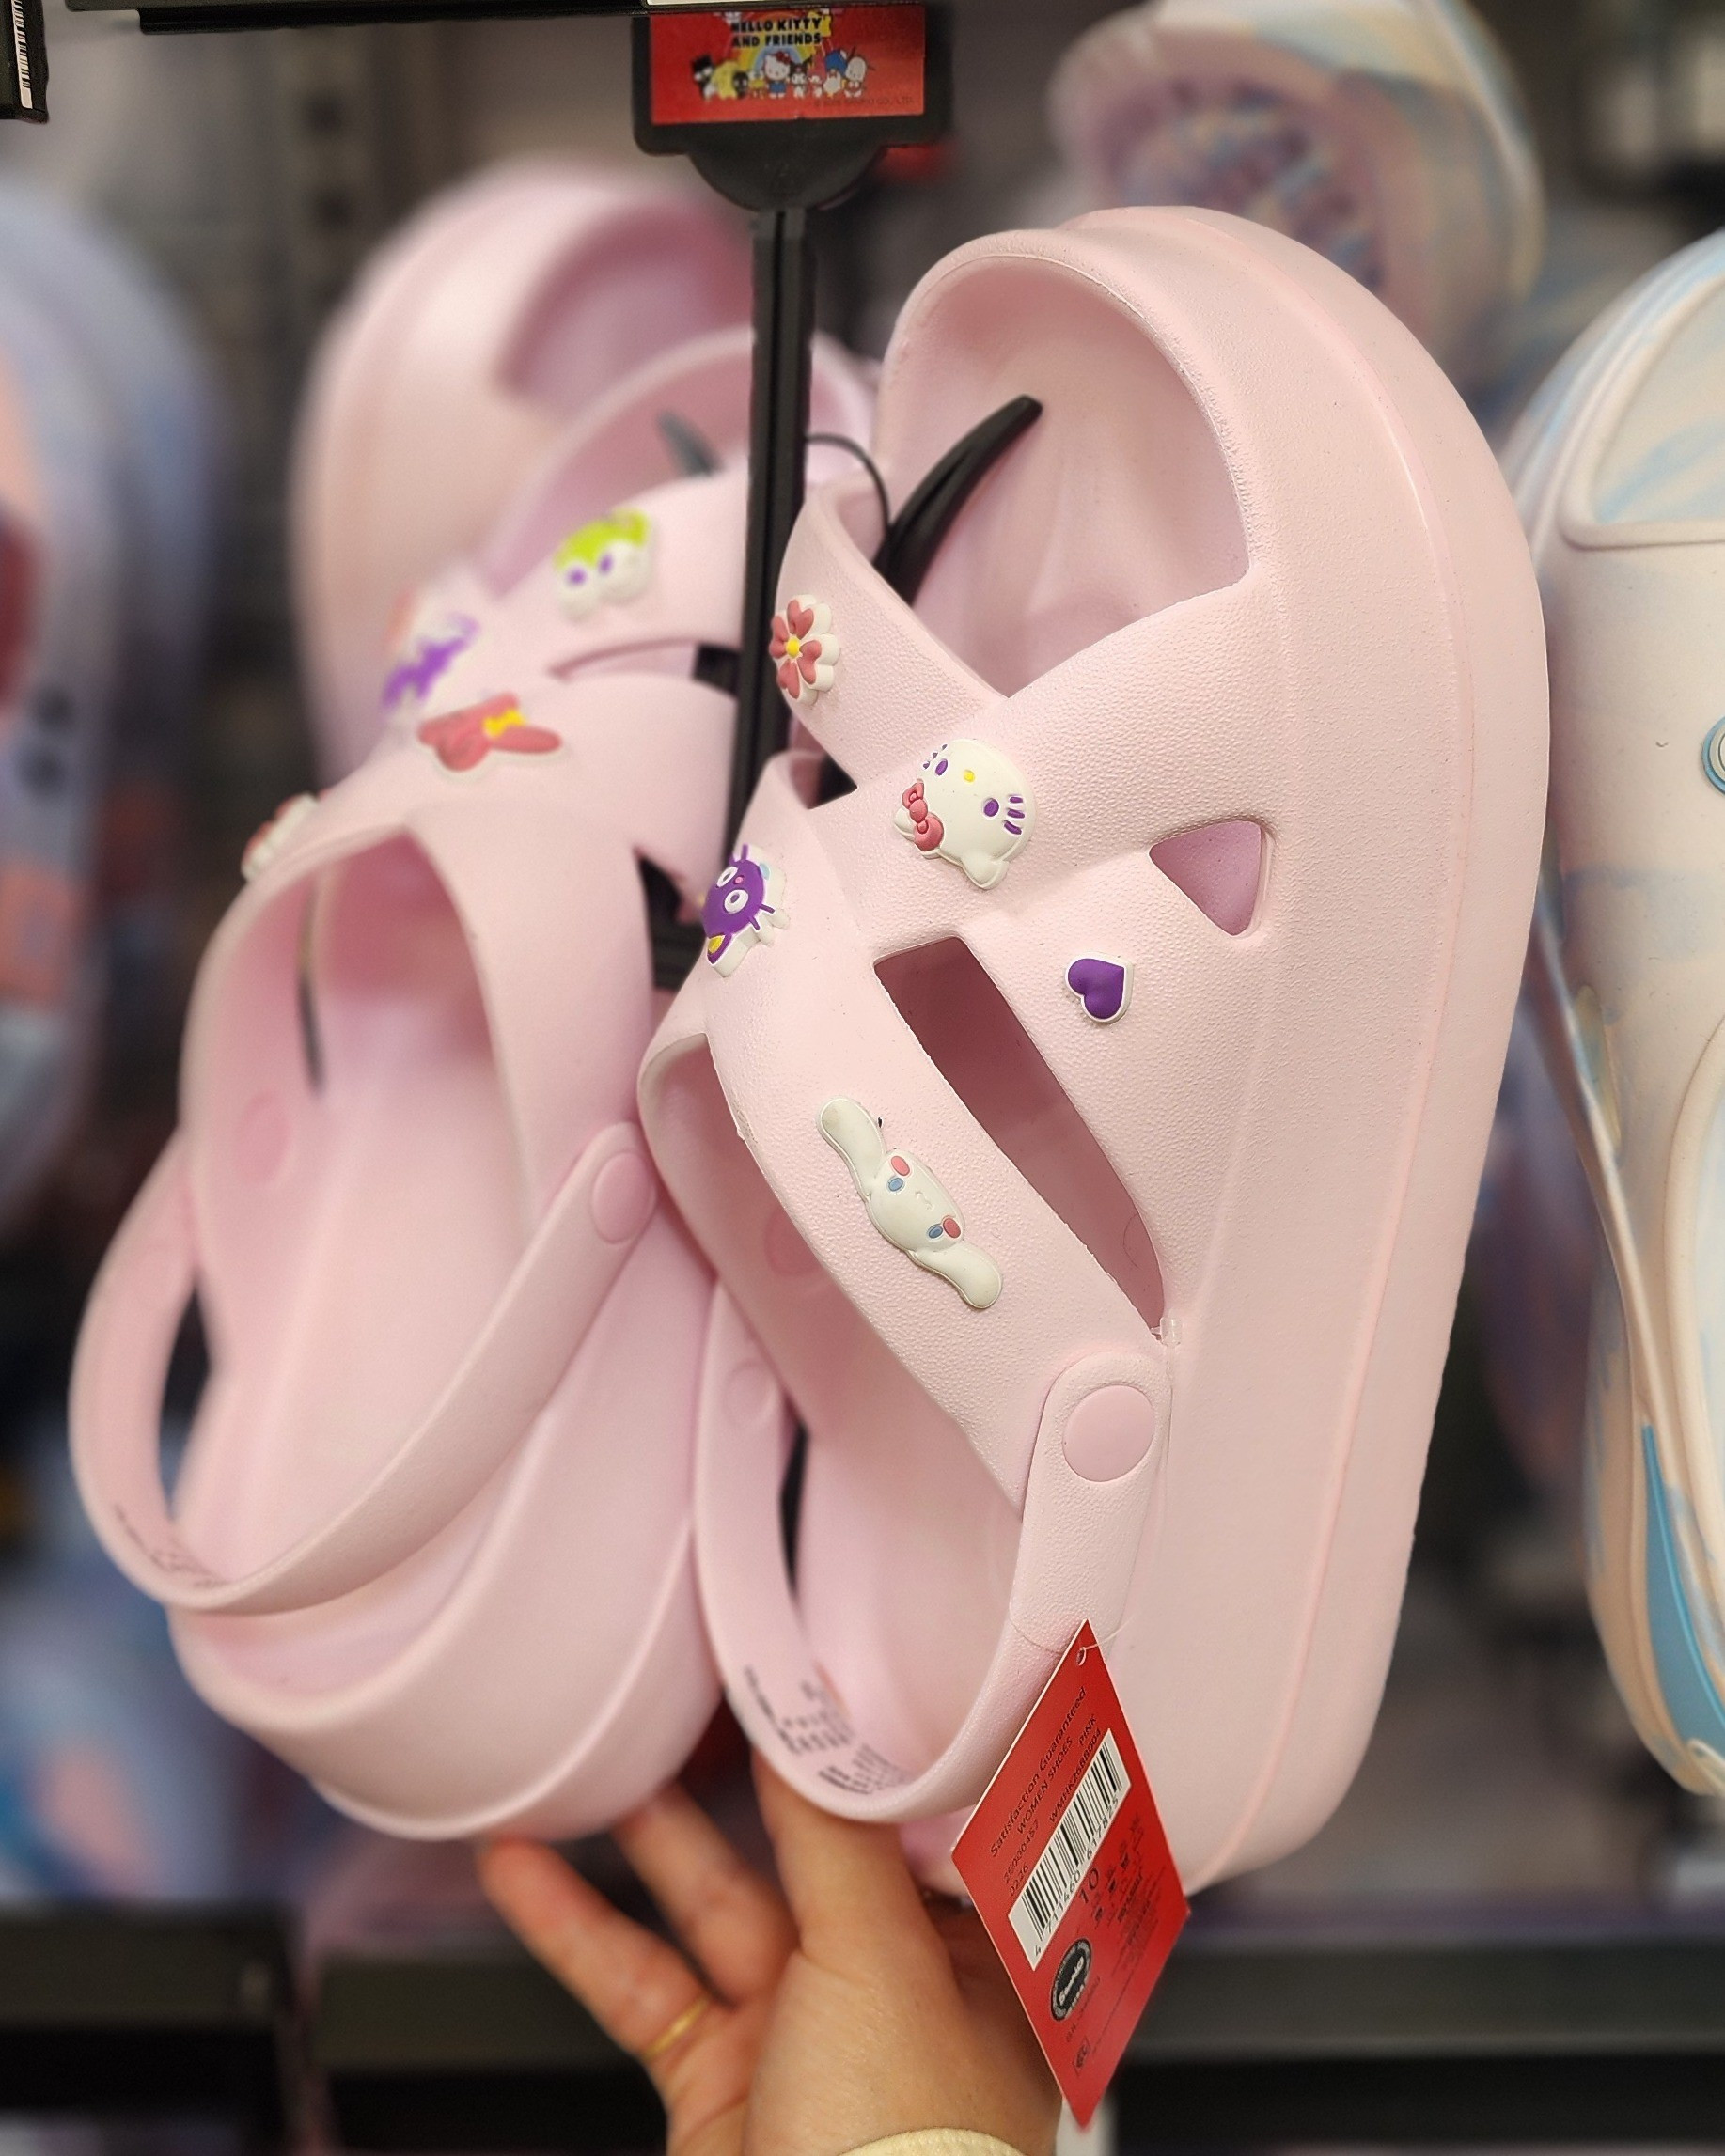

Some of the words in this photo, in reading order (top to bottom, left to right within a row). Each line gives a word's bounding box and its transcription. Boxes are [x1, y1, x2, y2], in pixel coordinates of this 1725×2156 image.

[731, 20, 773, 32] HELLO
[777, 18, 822, 31] KITTY
[732, 36, 760, 47] AND
[765, 33, 821, 46] FRIENDS
[1078, 1714, 1097, 1746] PINK
[990, 1773, 1040, 1858] Satisfaction
[1039, 1685, 1086, 1772] Guaranteed
[1017, 1780, 1048, 1835] WOMEN
[1047, 1736, 1073, 1782] SHOES
[1045, 1869, 1081, 1934] 711460
[1086, 1796, 1119, 1860] 617825
[1079, 1867, 1099, 1904] 10
